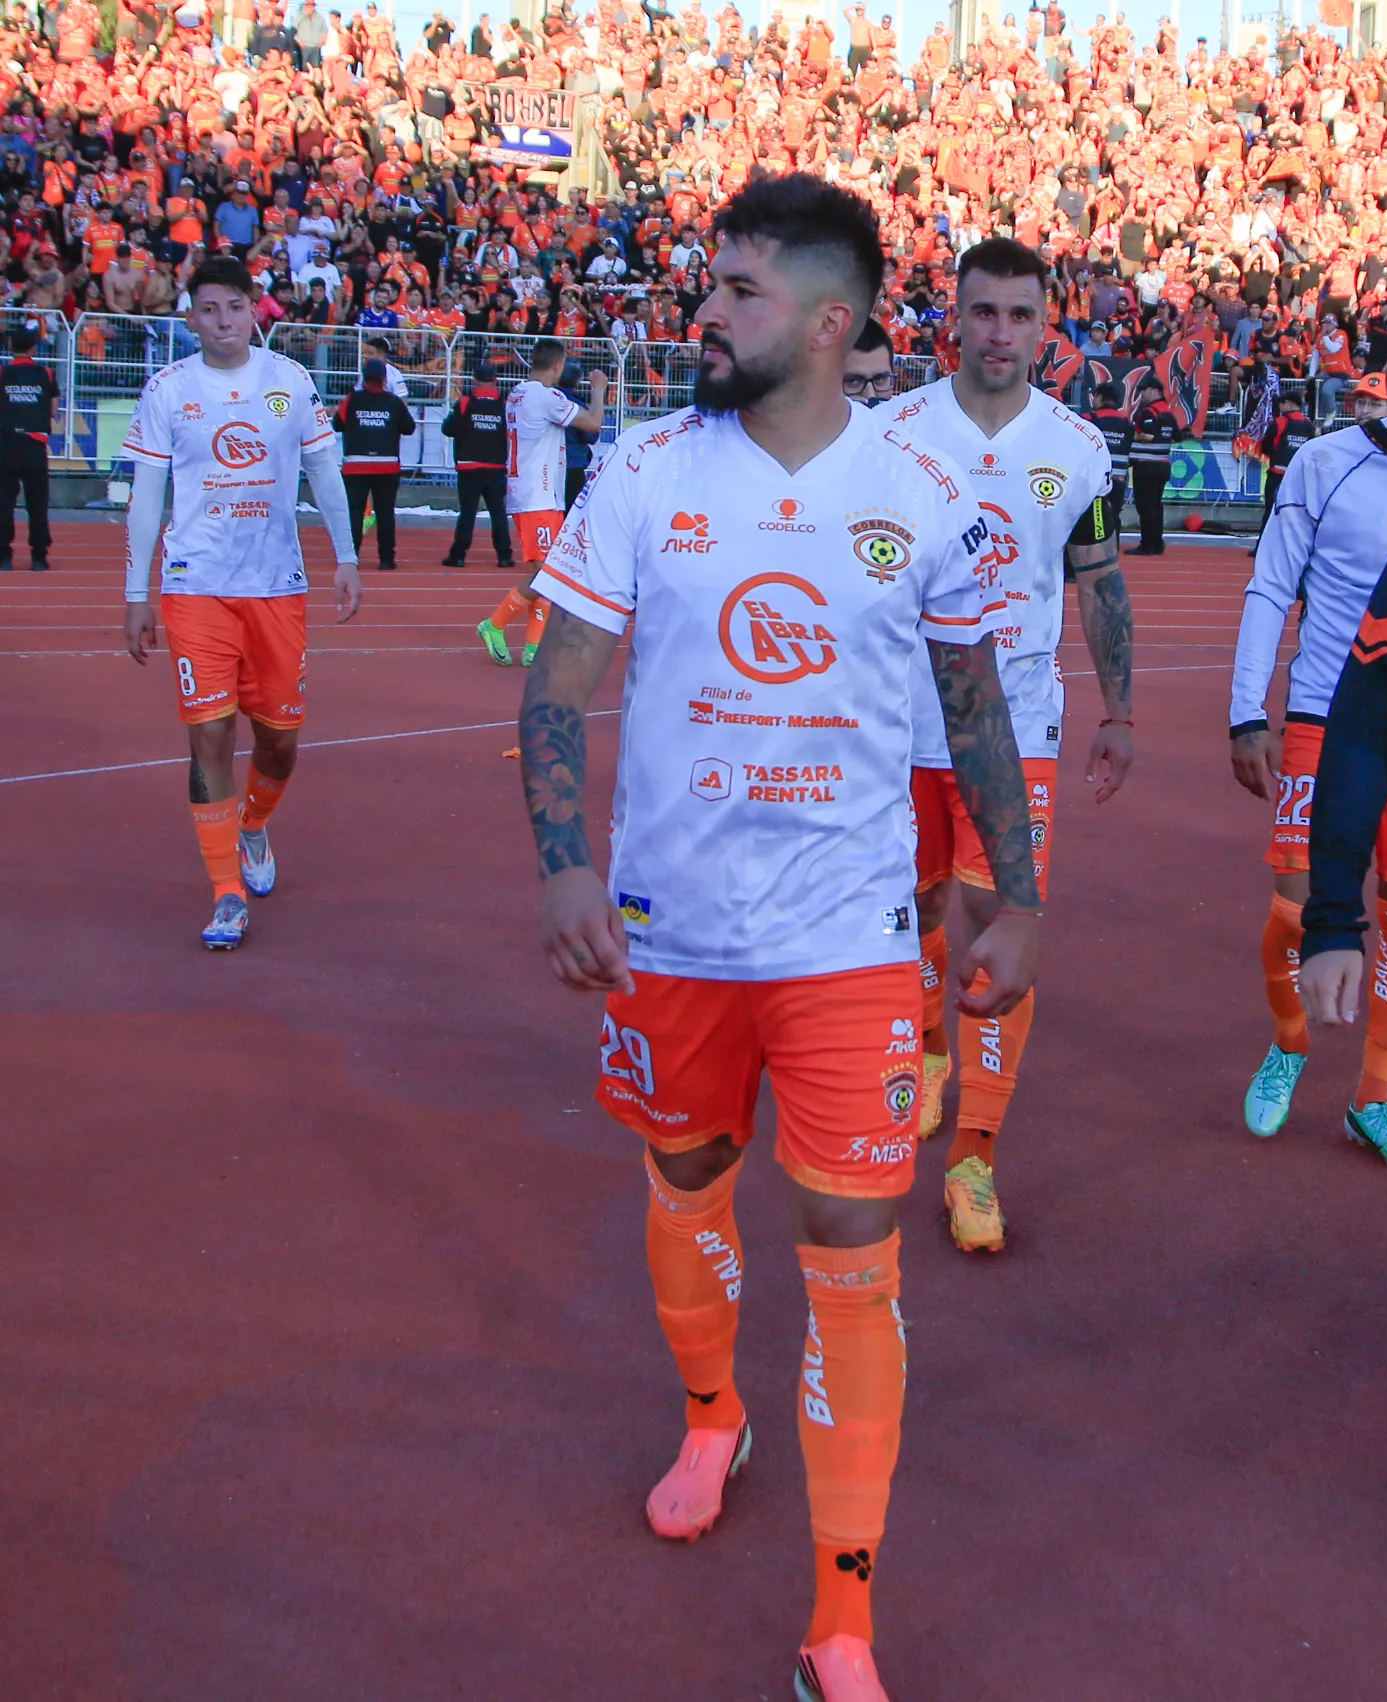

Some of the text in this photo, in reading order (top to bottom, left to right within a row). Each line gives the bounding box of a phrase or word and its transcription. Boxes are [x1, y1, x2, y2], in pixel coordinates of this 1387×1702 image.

[355, 410, 390, 419] SEGURIDAD
[359, 419, 386, 427] PRIVADA
[471, 414, 502, 423] SEGURIDAD
[473, 422, 498, 431] PRIVADA
[969, 468, 1007, 477] CODELCO
[758, 521, 817, 534] CODELCO
[853, 519, 914, 542] COBRELOA
[742, 600, 784, 619] EL
[750, 619, 838, 663] ABRA
[177, 656, 197, 696] 8
[700, 686, 753, 701] Filial de
[743, 764, 844, 783] TASSARA
[748, 786, 836, 803] RENTAL
[1275, 774, 1316, 826] 22
[600, 1011, 655, 1096] 29
[694, 1230, 742, 1302] BALAP
